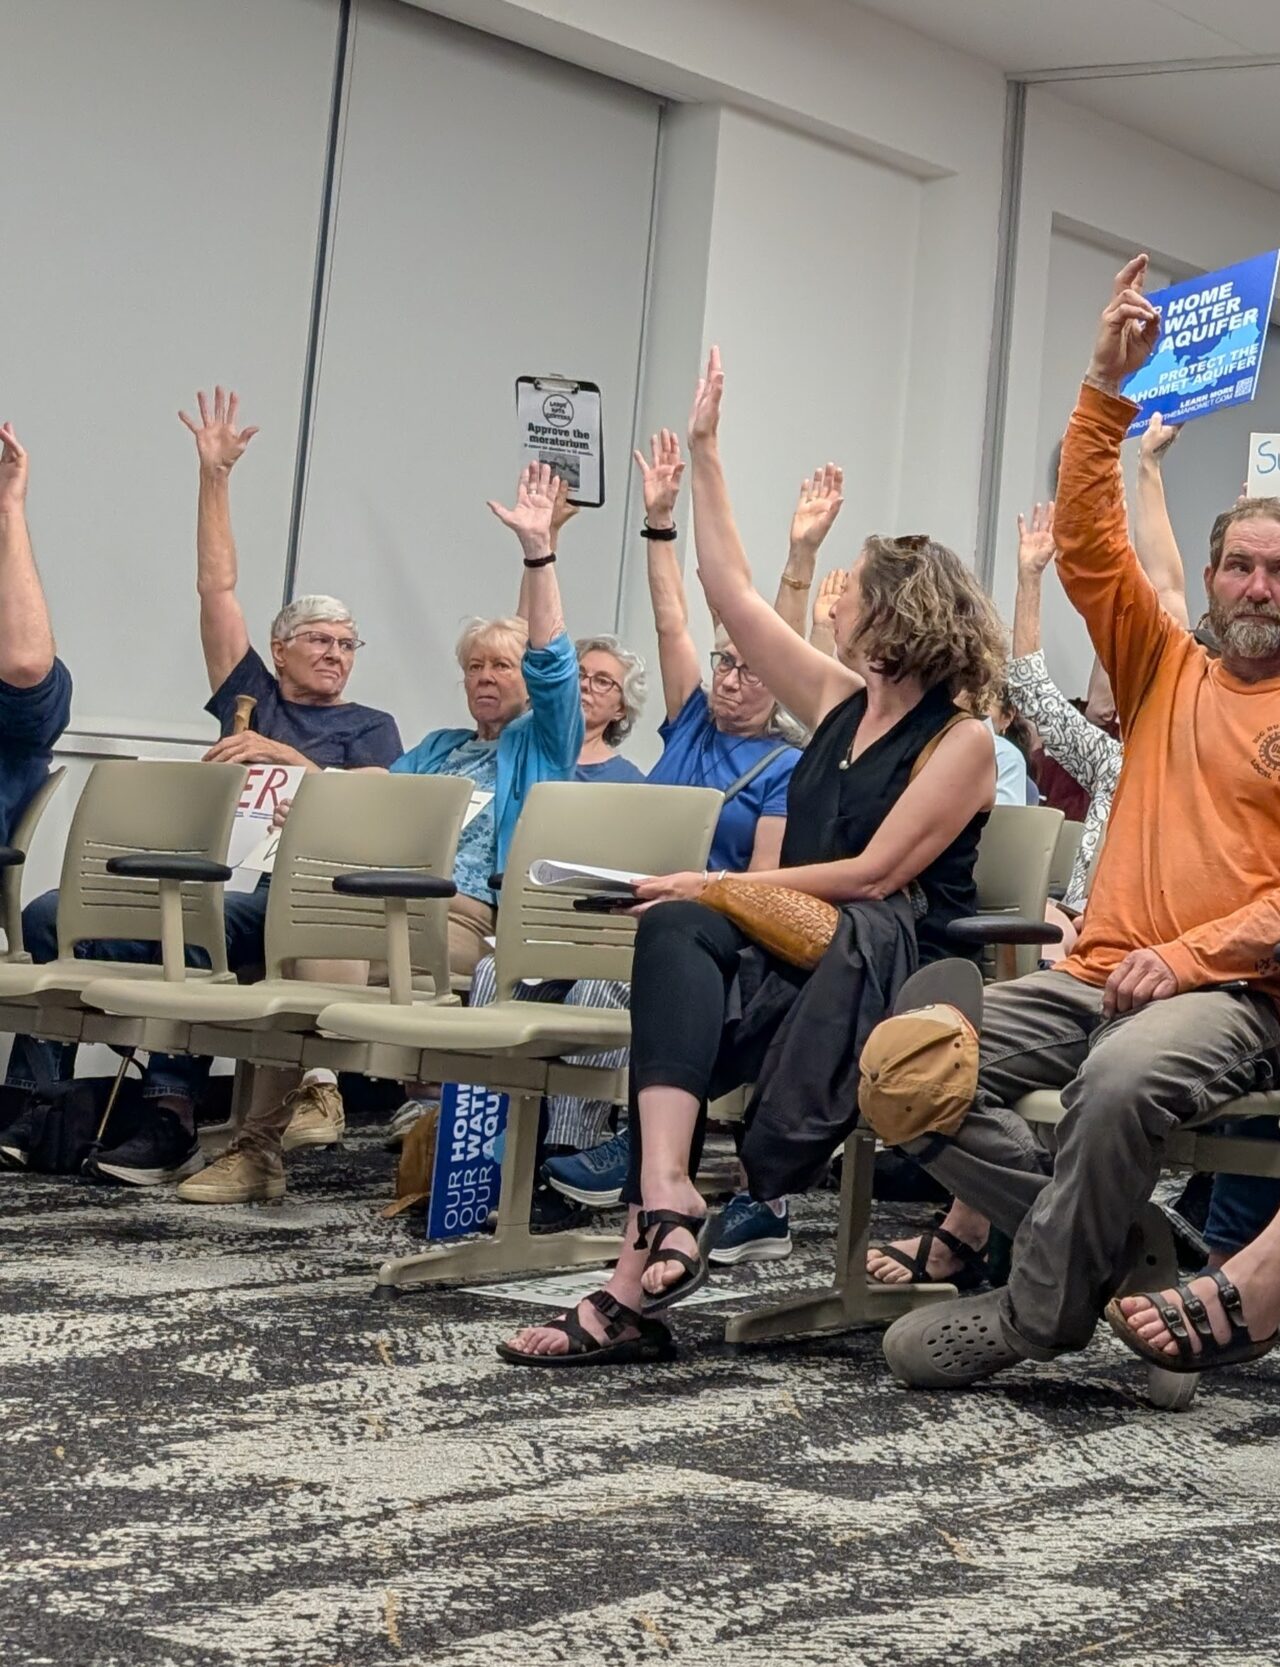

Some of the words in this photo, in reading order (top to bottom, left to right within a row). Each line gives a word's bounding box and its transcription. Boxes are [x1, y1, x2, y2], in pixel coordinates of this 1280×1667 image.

[1164, 296, 1241, 335] WATER
[1167, 282, 1234, 317] HOME
[1158, 307, 1259, 352] AQUIFER
[1130, 376, 1193, 404] AHOMET
[1193, 357, 1257, 386] AQUIFER
[1158, 354, 1226, 384] PROTECT
[1230, 343, 1259, 362] THE
[1180, 394, 1208, 408] LEARN
[1210, 385, 1235, 399] MORE
[528, 422, 570, 437] Approve
[573, 429, 590, 440] the
[529, 435, 590, 450] moratorium
[1250, 758, 1272, 779] LOCAL
[466, 1084, 486, 1161] WAT
[444, 1169, 464, 1230] OUR
[459, 1166, 478, 1227] OUR
[475, 1164, 494, 1224] OUR
